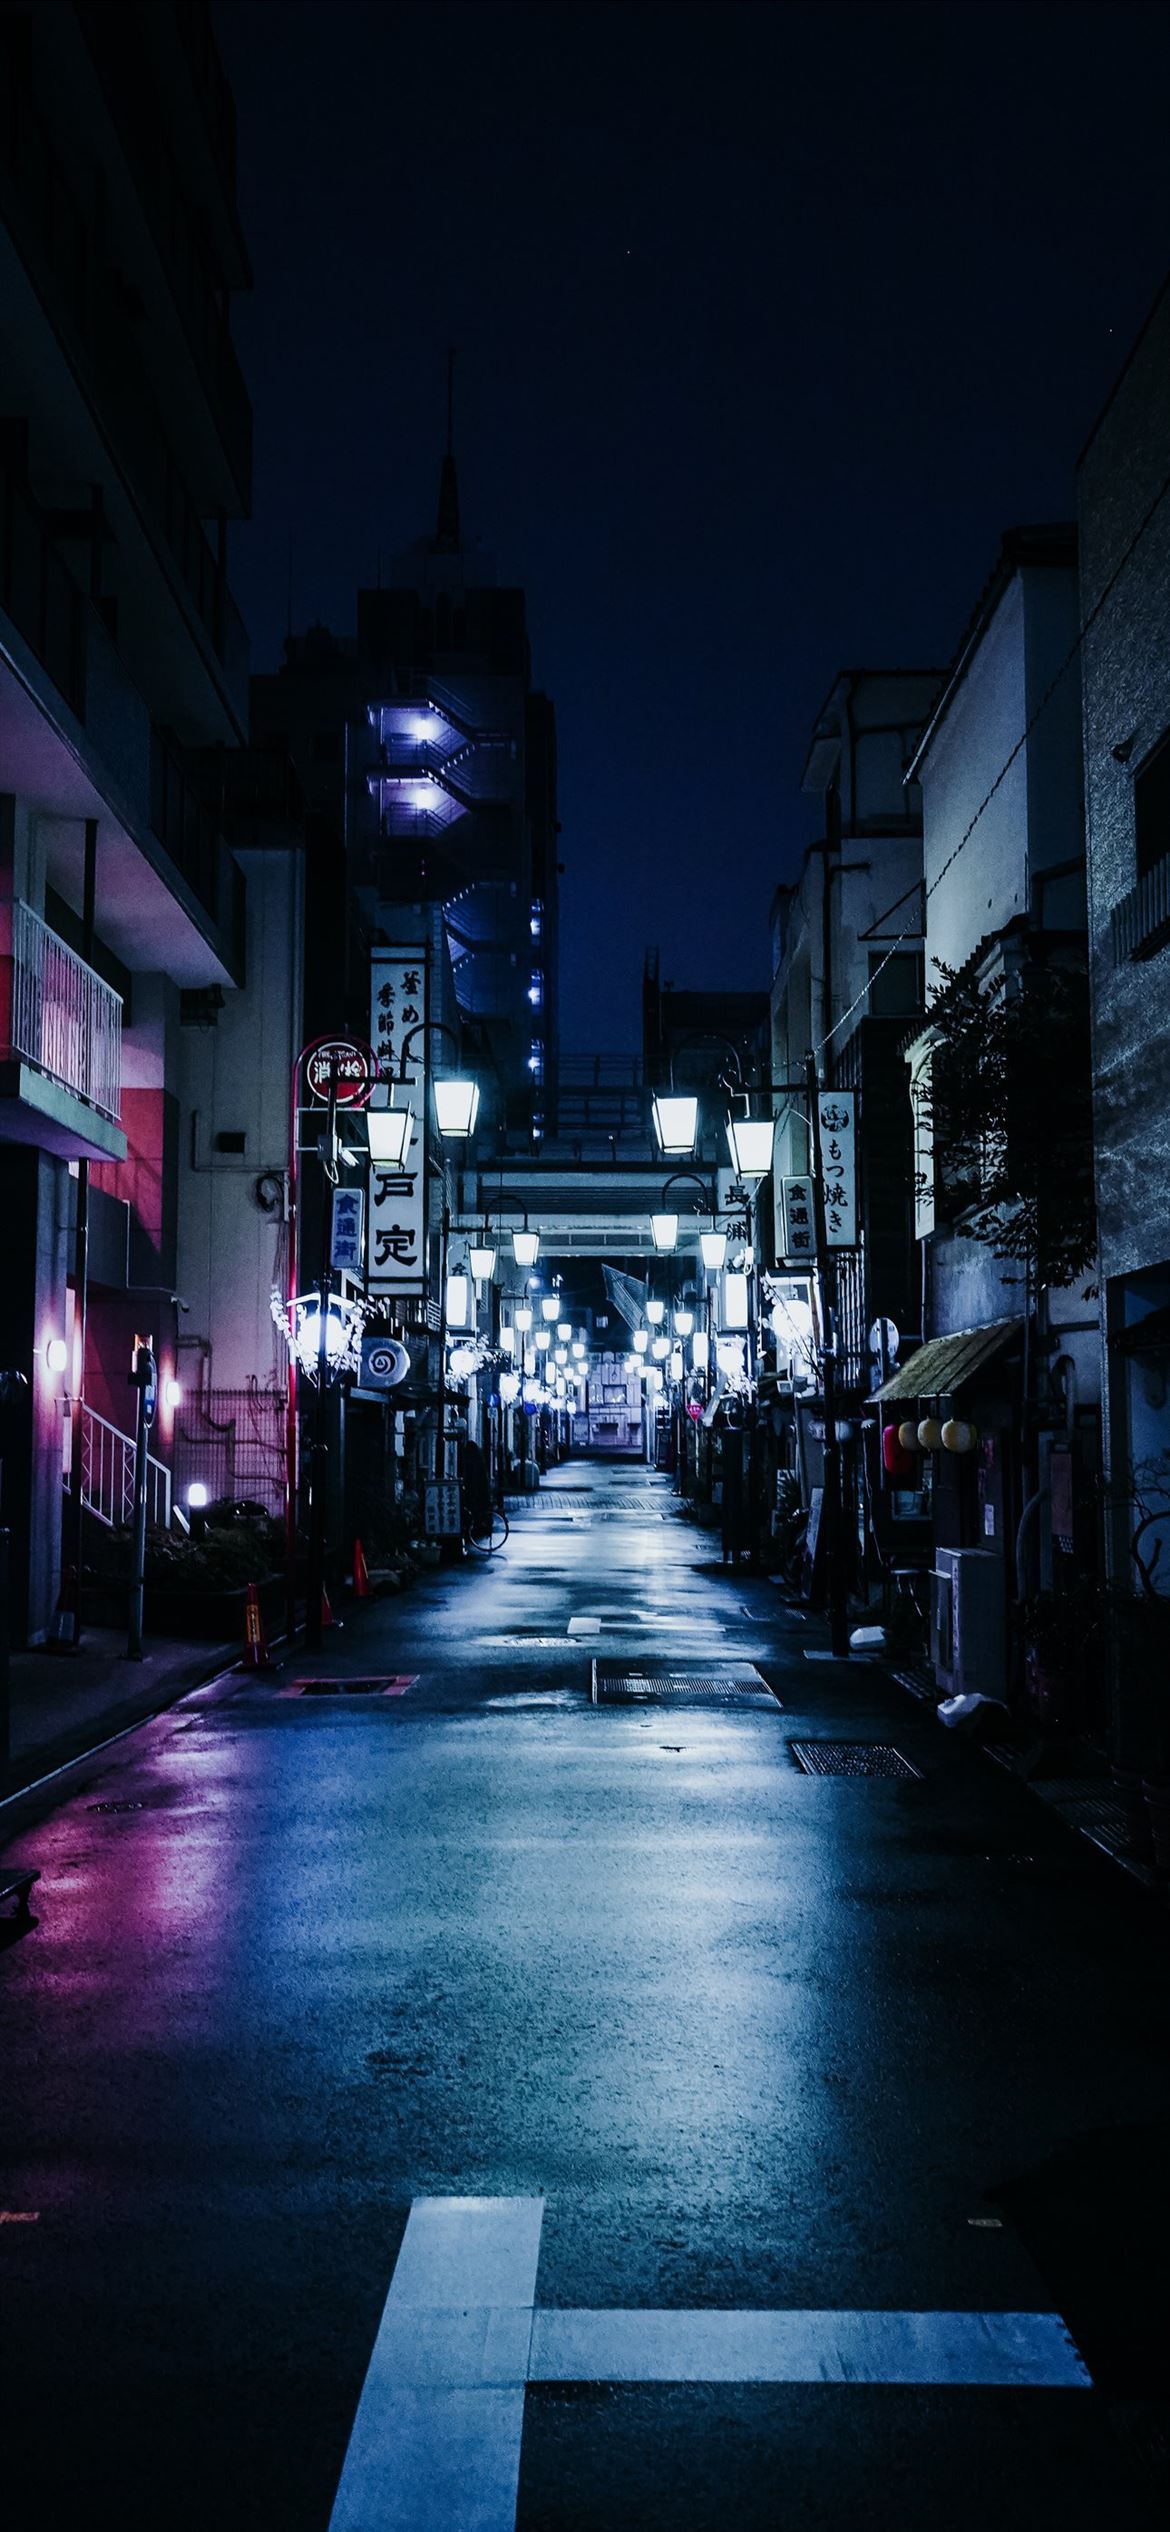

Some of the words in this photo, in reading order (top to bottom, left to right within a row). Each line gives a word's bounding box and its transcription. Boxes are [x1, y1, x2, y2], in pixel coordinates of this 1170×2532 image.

[374, 1138, 418, 1266] 戸定
[788, 1183, 811, 1249] 食通街
[823, 1139, 848, 1233] もつ焼き
[334, 1194, 360, 1261] 食通街
